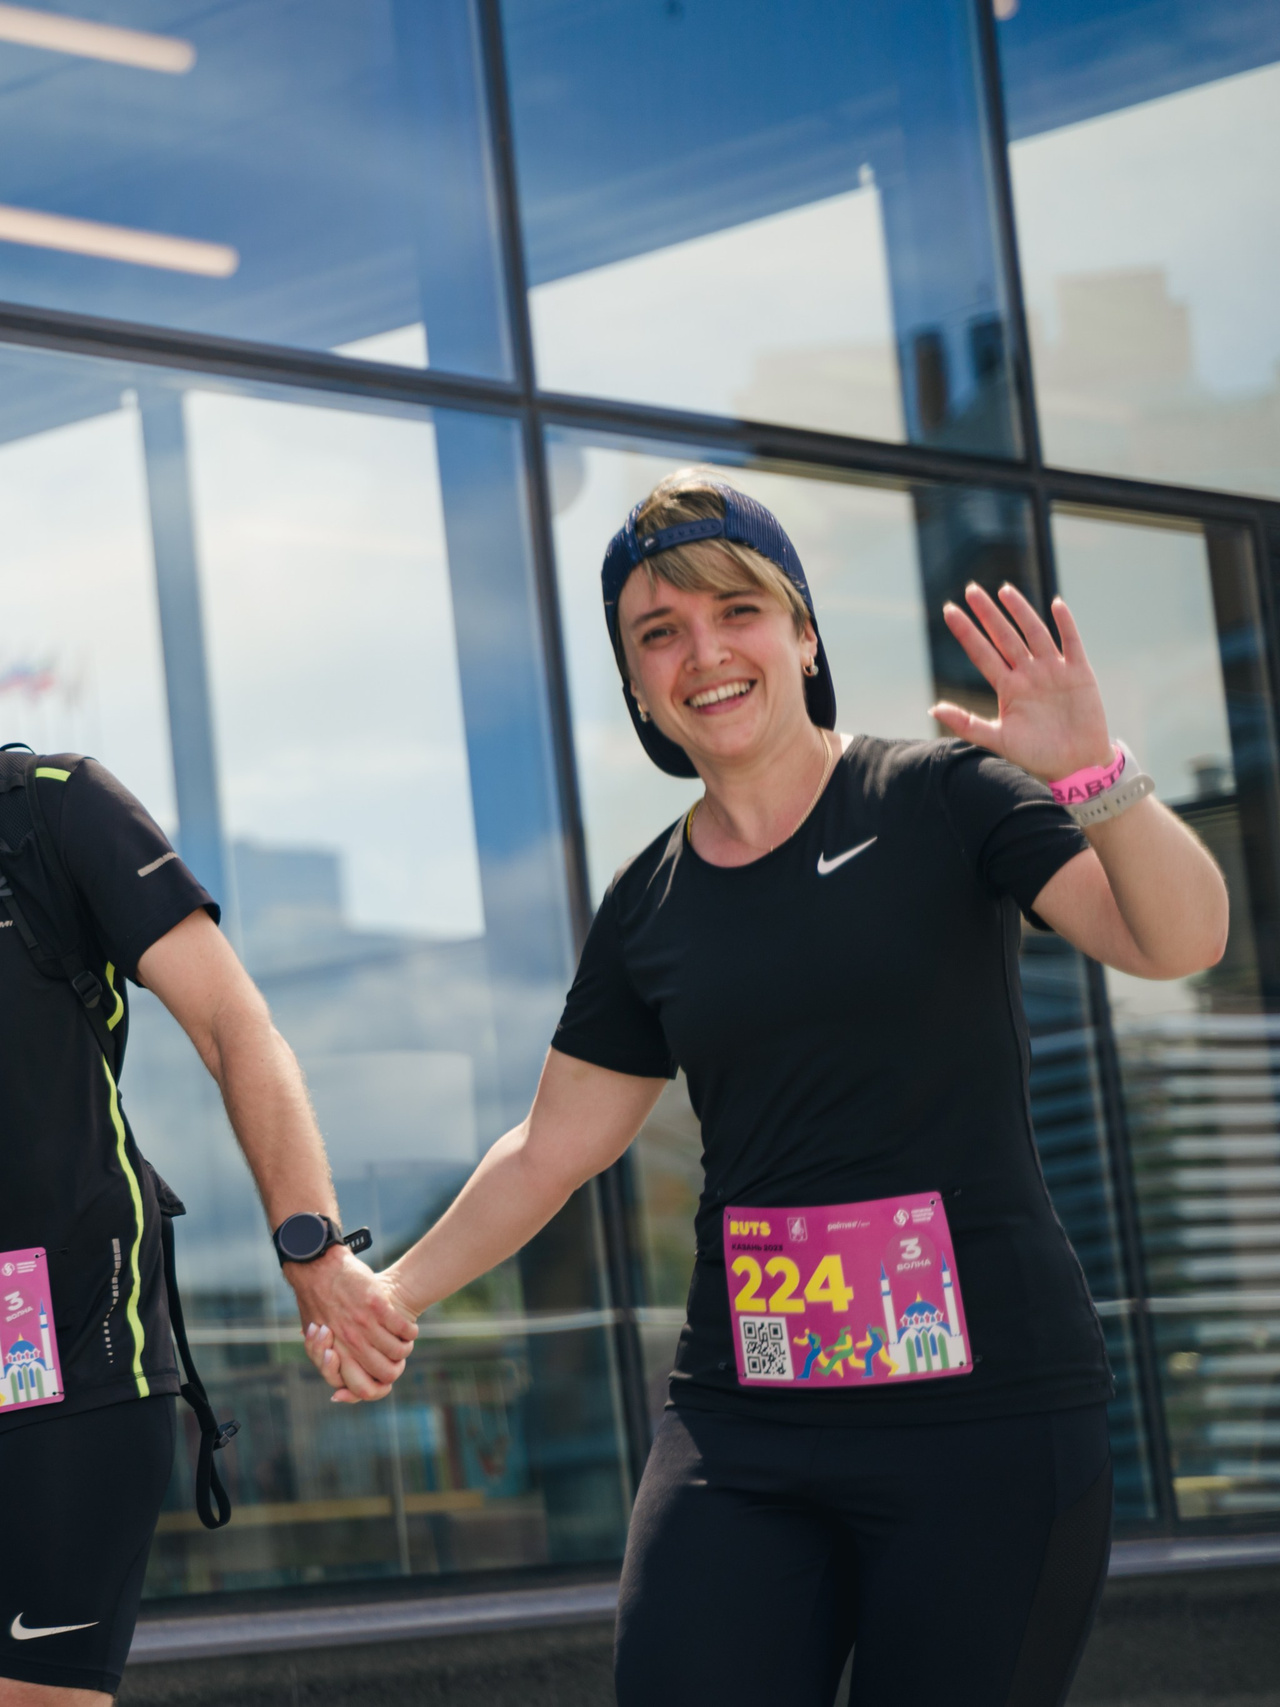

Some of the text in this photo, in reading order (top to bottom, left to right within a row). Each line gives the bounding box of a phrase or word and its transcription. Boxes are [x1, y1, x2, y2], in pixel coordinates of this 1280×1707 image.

[729, 1220, 771, 1237] RUTS
[731, 1243, 783, 1252] КАЗАНЬ 2023
[899, 1237, 922, 1260] 3
[896, 1258, 932, 1272] ВОЛНА
[731, 1253, 854, 1314] 224
[4, 1290, 24, 1311] 3
[5, 1305, 34, 1322] ВОЛНА
